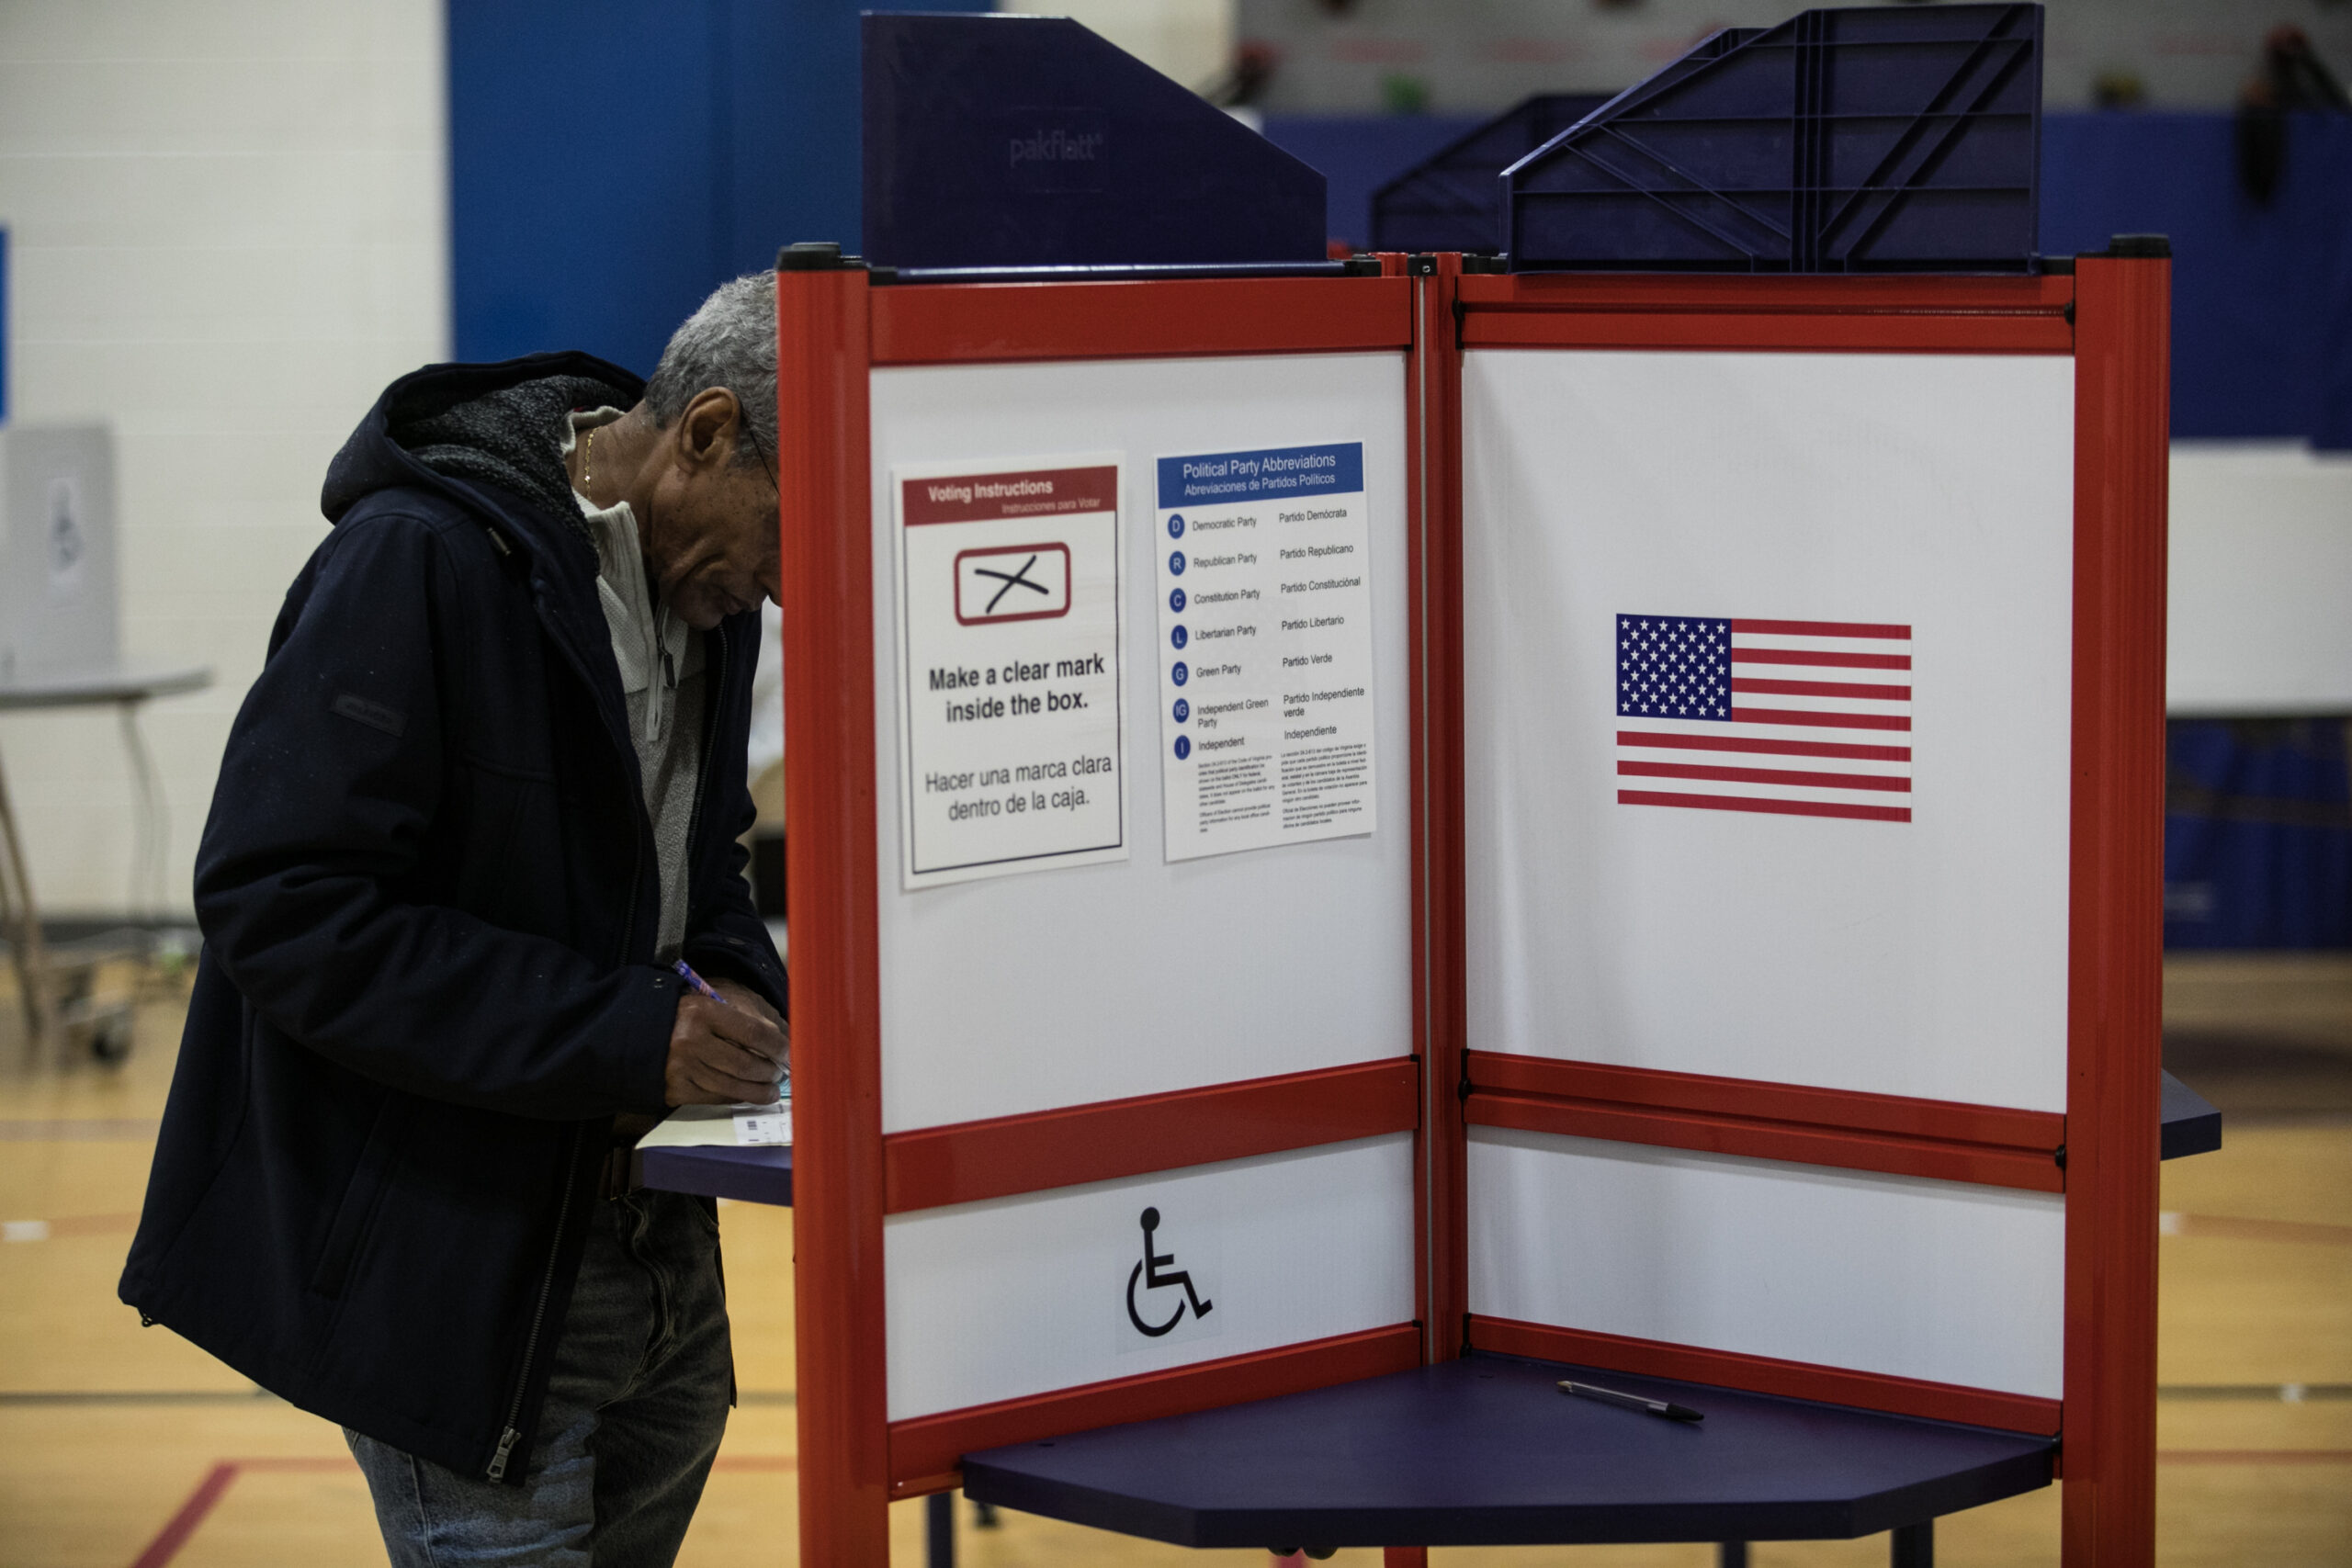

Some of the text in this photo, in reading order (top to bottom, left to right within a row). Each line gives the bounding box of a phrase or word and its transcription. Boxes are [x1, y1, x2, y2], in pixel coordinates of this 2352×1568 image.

[1183, 454, 1336, 479] Political Party Abbreviations
[928, 479, 1053, 503] Voting Instructions
[1184, 479, 1247, 496] Abreviaciones
[1249, 478, 1260, 491] de
[1261, 475, 1297, 490] Partidos
[1001, 497, 1101, 514] Instrucciones para Votar
[1279, 508, 1347, 523] Partido Demócrata
[1172, 520, 1181, 533] D
[1193, 516, 1257, 532] Democratic Party
[1280, 544, 1354, 559] Partido Republicano
[1173, 558, 1182, 570] R
[1193, 553, 1257, 569] Republican Party
[1281, 582, 1306, 593] Partido
[1173, 594, 1182, 607] C
[1194, 589, 1261, 604] Constitution Party
[1282, 615, 1344, 631] Partido Libertario
[1176, 632, 1182, 644] L
[1195, 626, 1257, 640] Libertarian Party
[1283, 654, 1332, 668] Partido Verde
[929, 653, 1105, 691] Make a clear mark
[1176, 668, 1184, 681] G
[1196, 664, 1241, 678] Green Party
[1283, 687, 1364, 705] Partido Independiente
[946, 689, 1089, 722] inside the box.
[1175, 704, 1187, 716] IG
[1197, 698, 1269, 716] Independent Green
[1283, 707, 1305, 718] verde
[1197, 718, 1217, 728] Party
[1284, 726, 1337, 740] Independiente
[1198, 737, 1245, 750] Independent
[925, 755, 1112, 794] Hacer una marca clara
[948, 786, 1091, 820] dentro de la caja.
